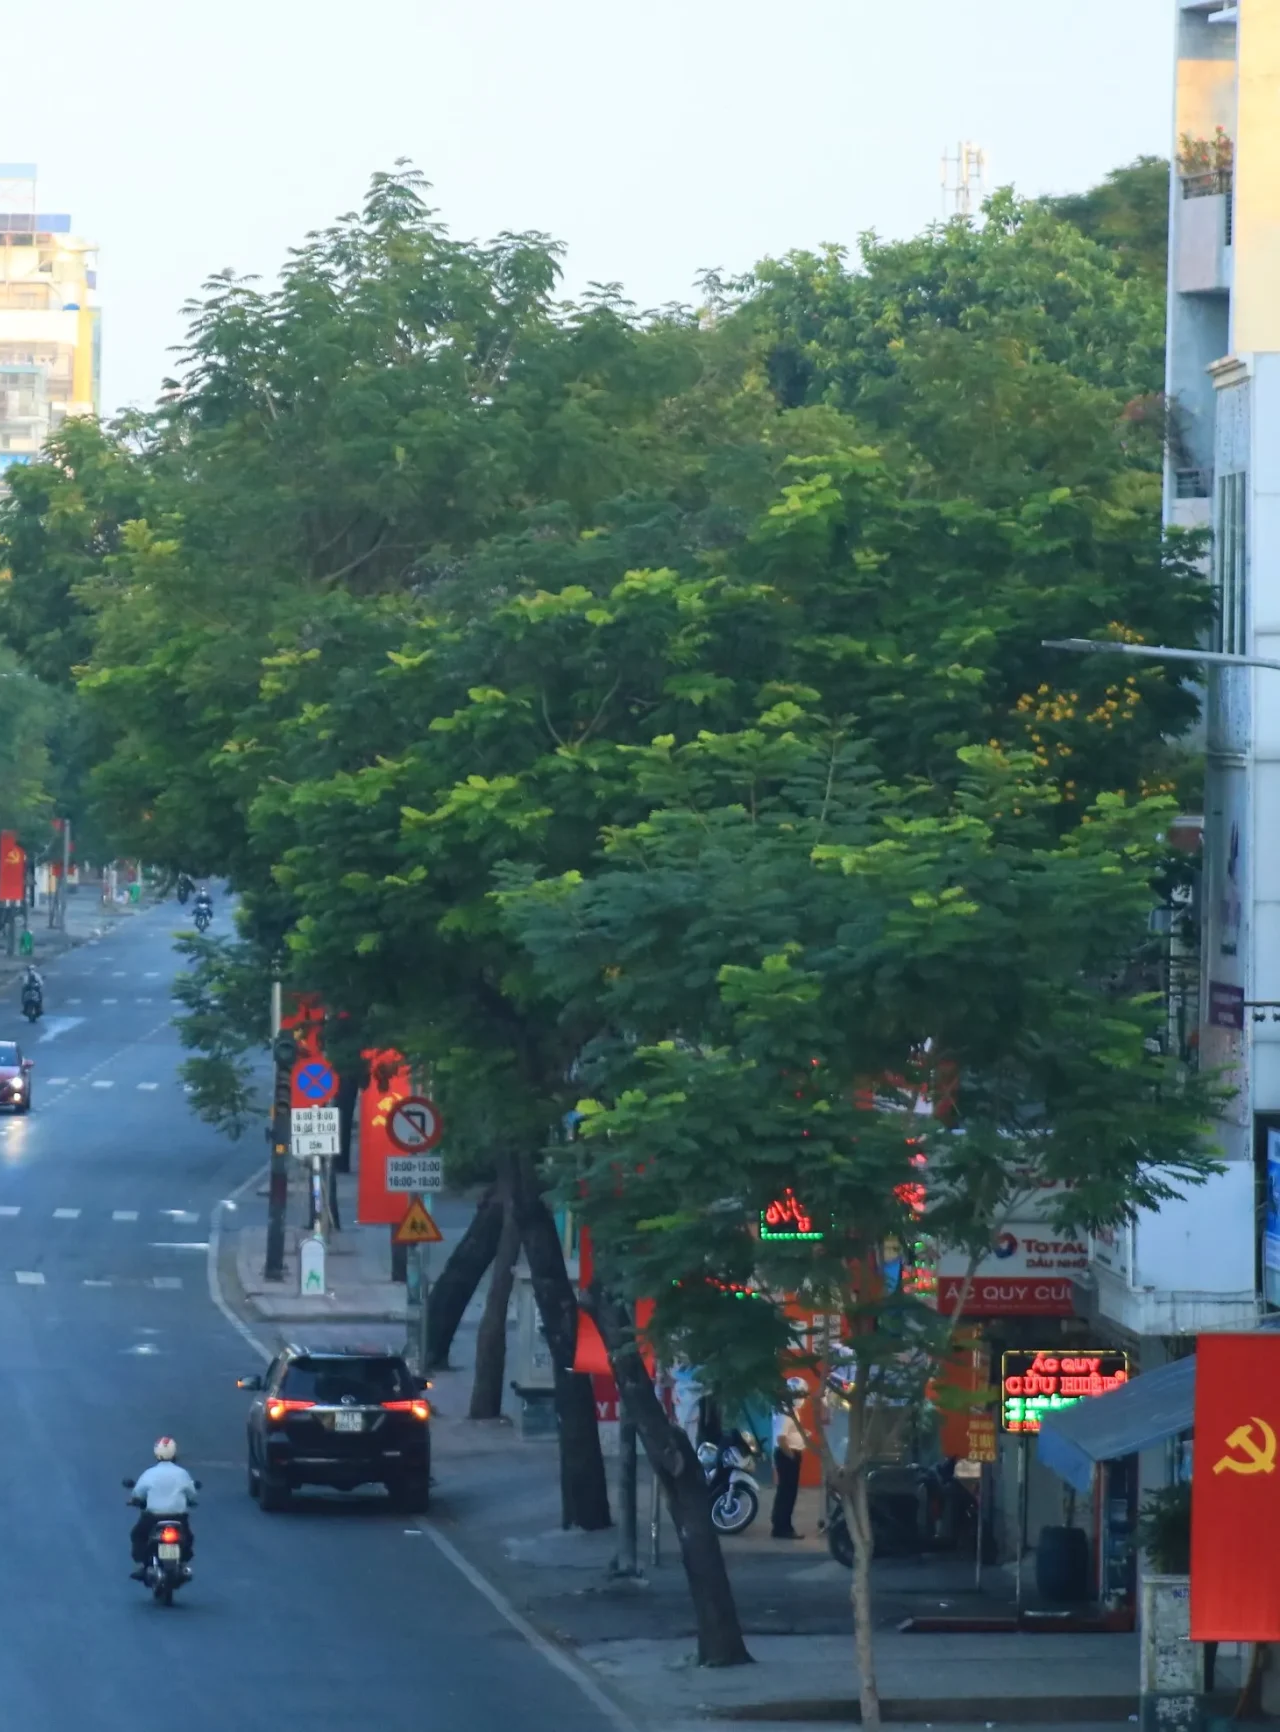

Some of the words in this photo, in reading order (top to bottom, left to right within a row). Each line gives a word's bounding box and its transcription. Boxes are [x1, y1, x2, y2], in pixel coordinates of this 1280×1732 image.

[1021, 1239, 1088, 1254] TOTAL
[982, 1285, 1028, 1301] QUY
[1061, 1358, 1100, 1373] QUY
